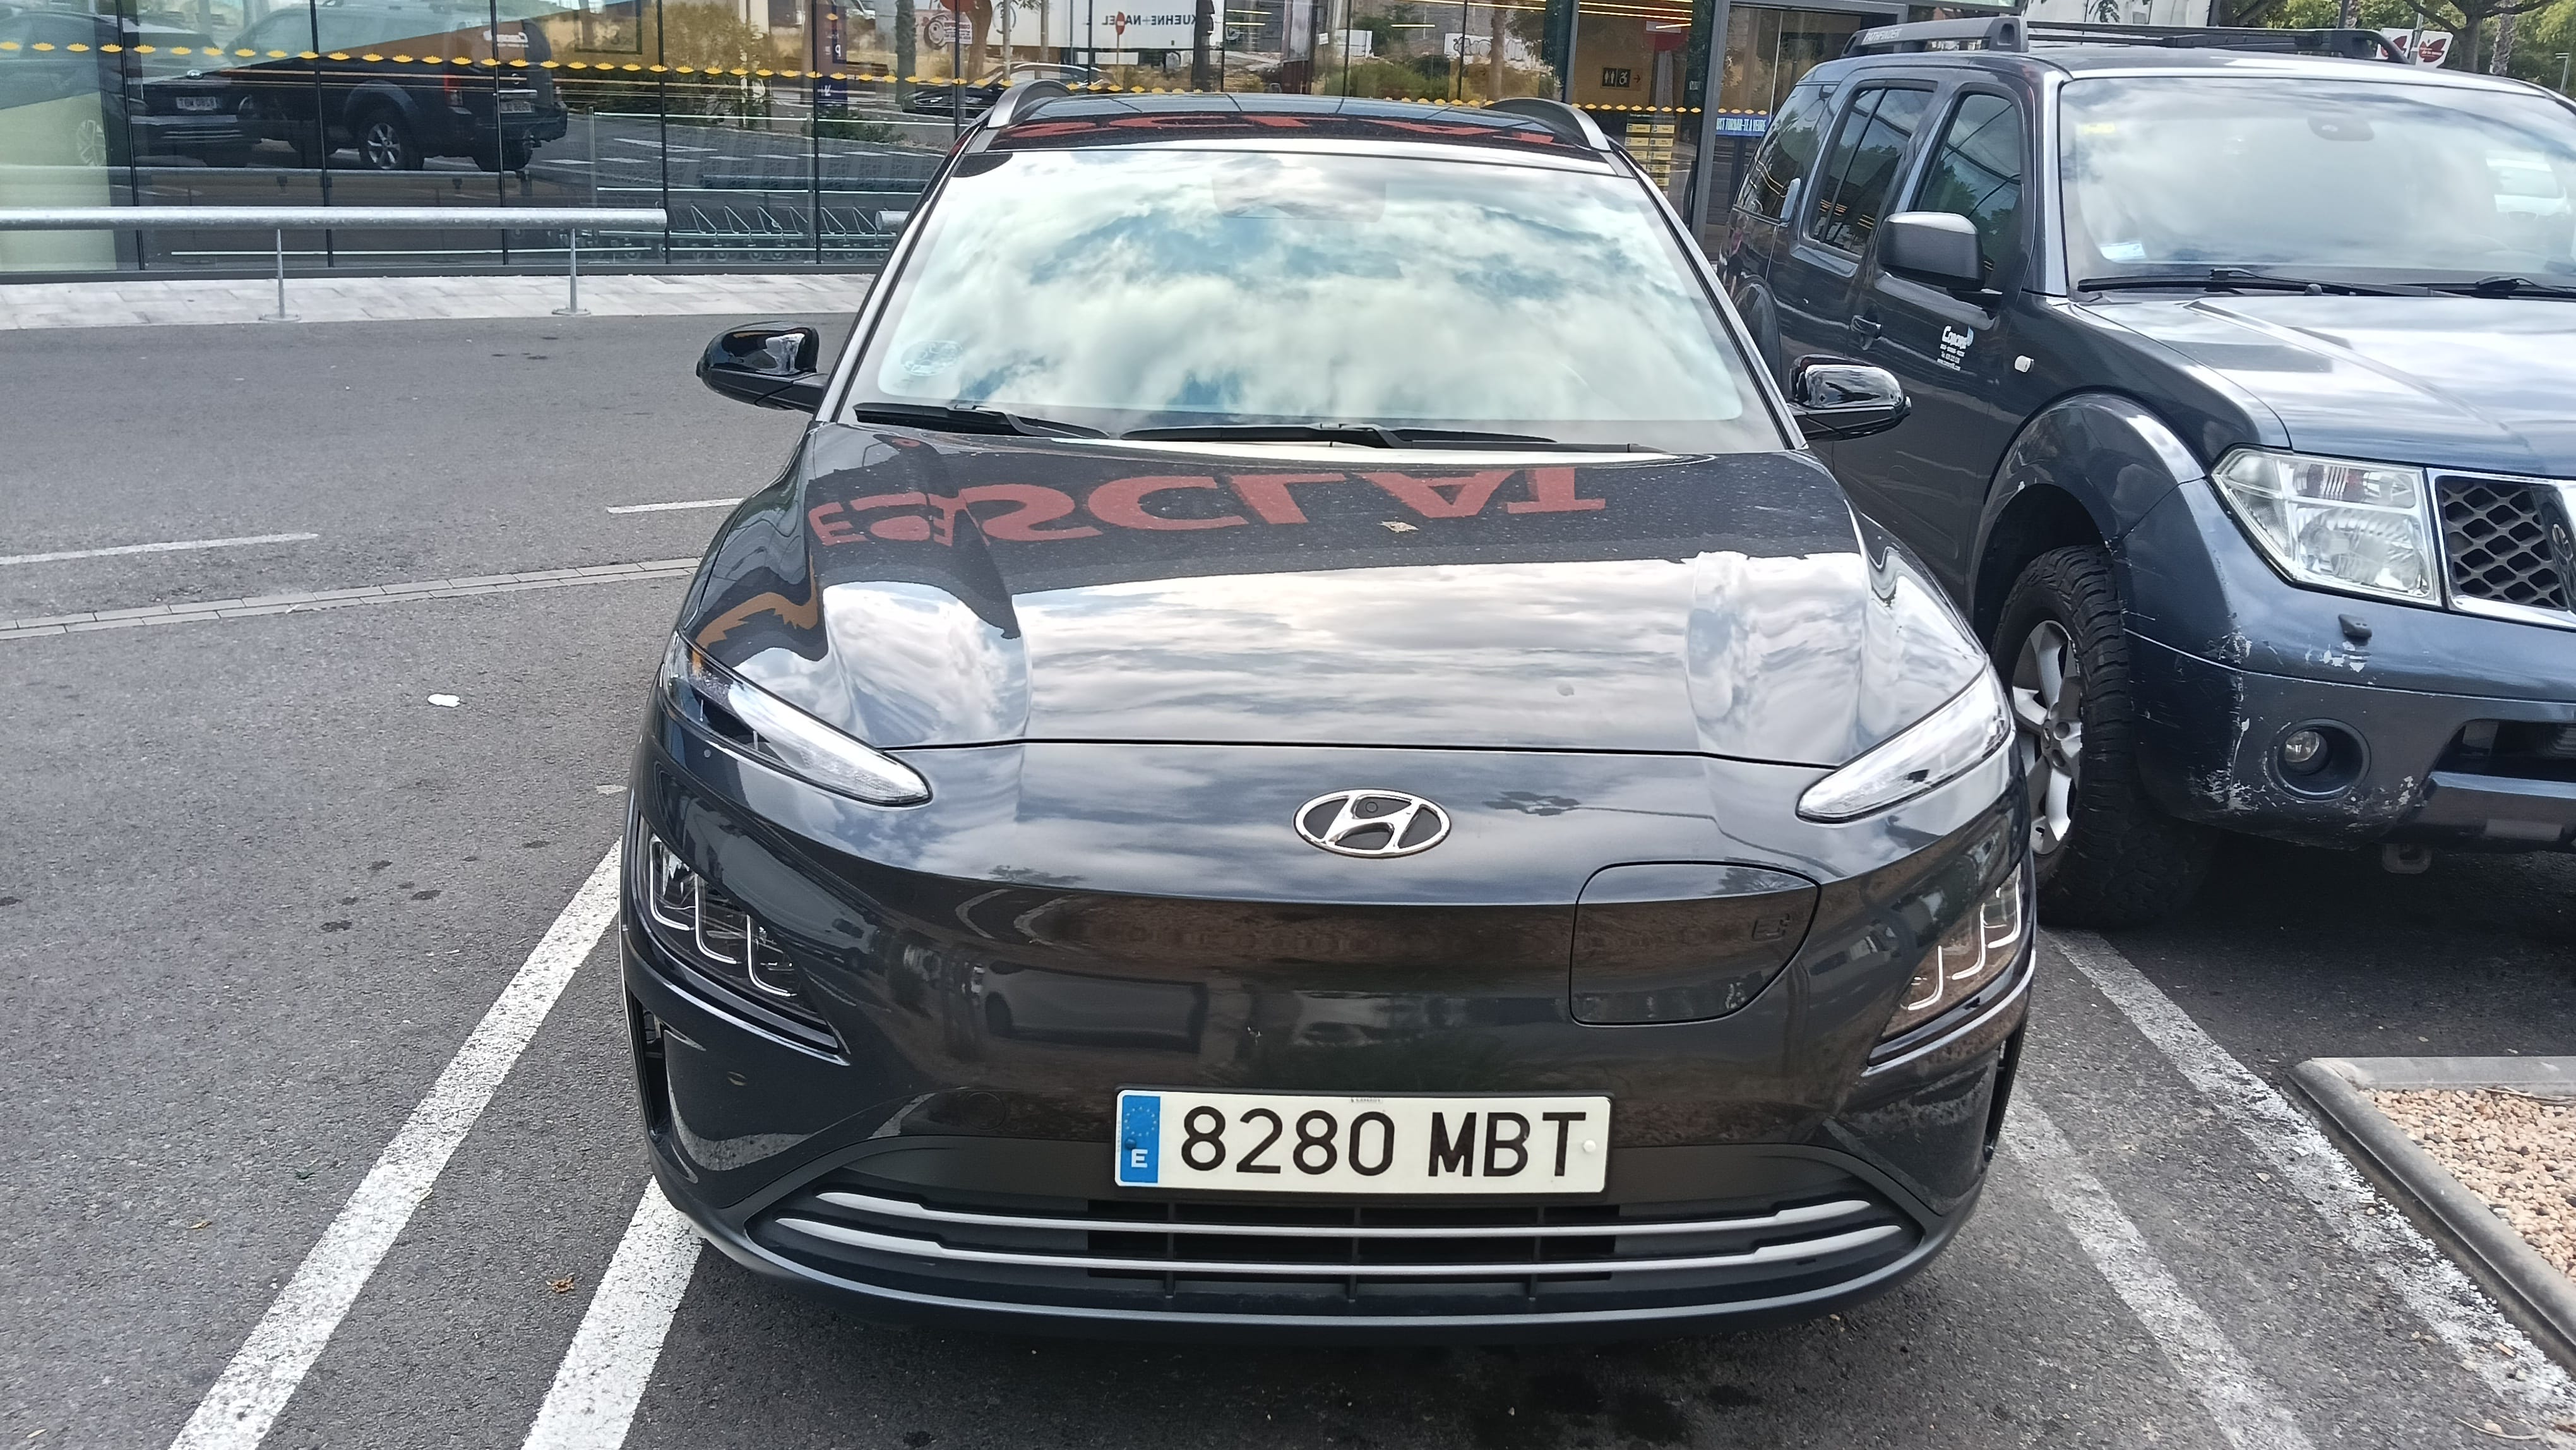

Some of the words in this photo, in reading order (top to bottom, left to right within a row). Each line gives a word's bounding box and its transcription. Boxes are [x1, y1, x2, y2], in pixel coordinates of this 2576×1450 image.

[1131, 1149, 1148, 1168] E
[1181, 1106, 1395, 1176] 8280
[1428, 1111, 1586, 1177] MBT
